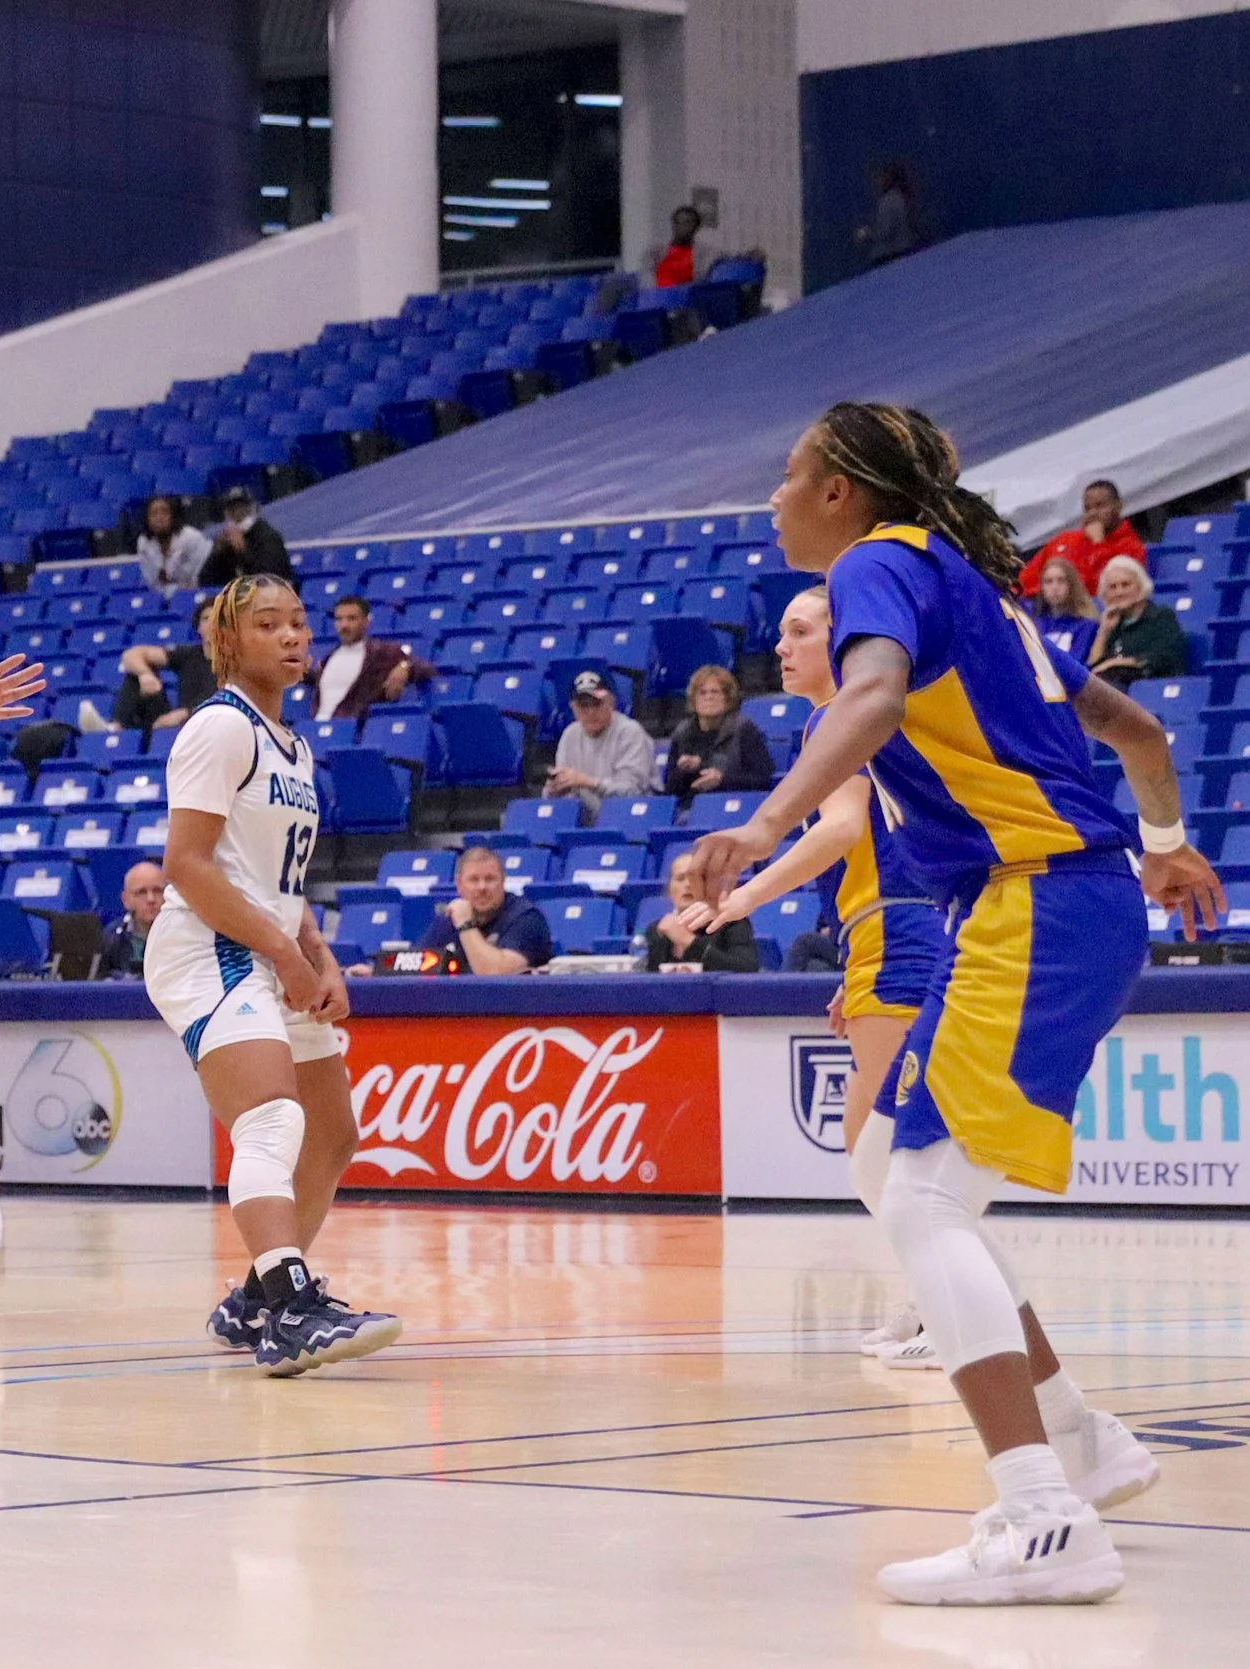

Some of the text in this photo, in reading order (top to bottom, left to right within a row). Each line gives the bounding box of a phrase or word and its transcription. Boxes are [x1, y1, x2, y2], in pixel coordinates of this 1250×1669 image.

[268, 772, 318, 814] AUGUS
[5, 1038, 95, 1157] 6
[336, 1026, 664, 1182] ca-Cola
[1072, 1036, 1240, 1142] alth
[73, 1118, 111, 1139] abc
[1071, 1161, 1240, 1187] NIVERSITY
